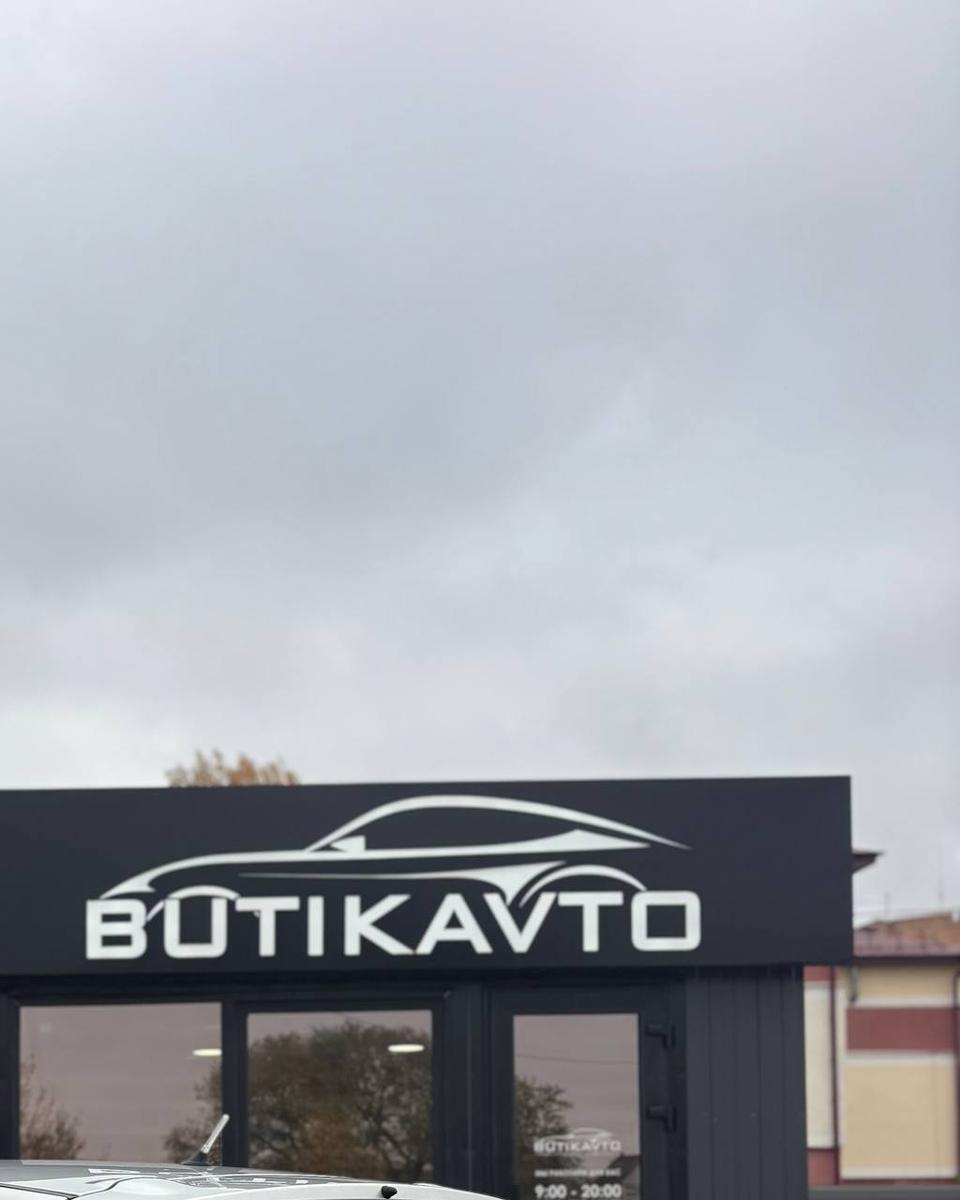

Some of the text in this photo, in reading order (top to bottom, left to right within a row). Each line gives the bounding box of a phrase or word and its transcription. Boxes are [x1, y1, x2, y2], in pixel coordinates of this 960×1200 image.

[85, 890, 702, 959] BUTIKAVTO
[533, 1139, 622, 1153] BUTIKAVTO
[534, 1183, 568, 1199] 9:00
[581, 1183, 622, 1199] 20:00
